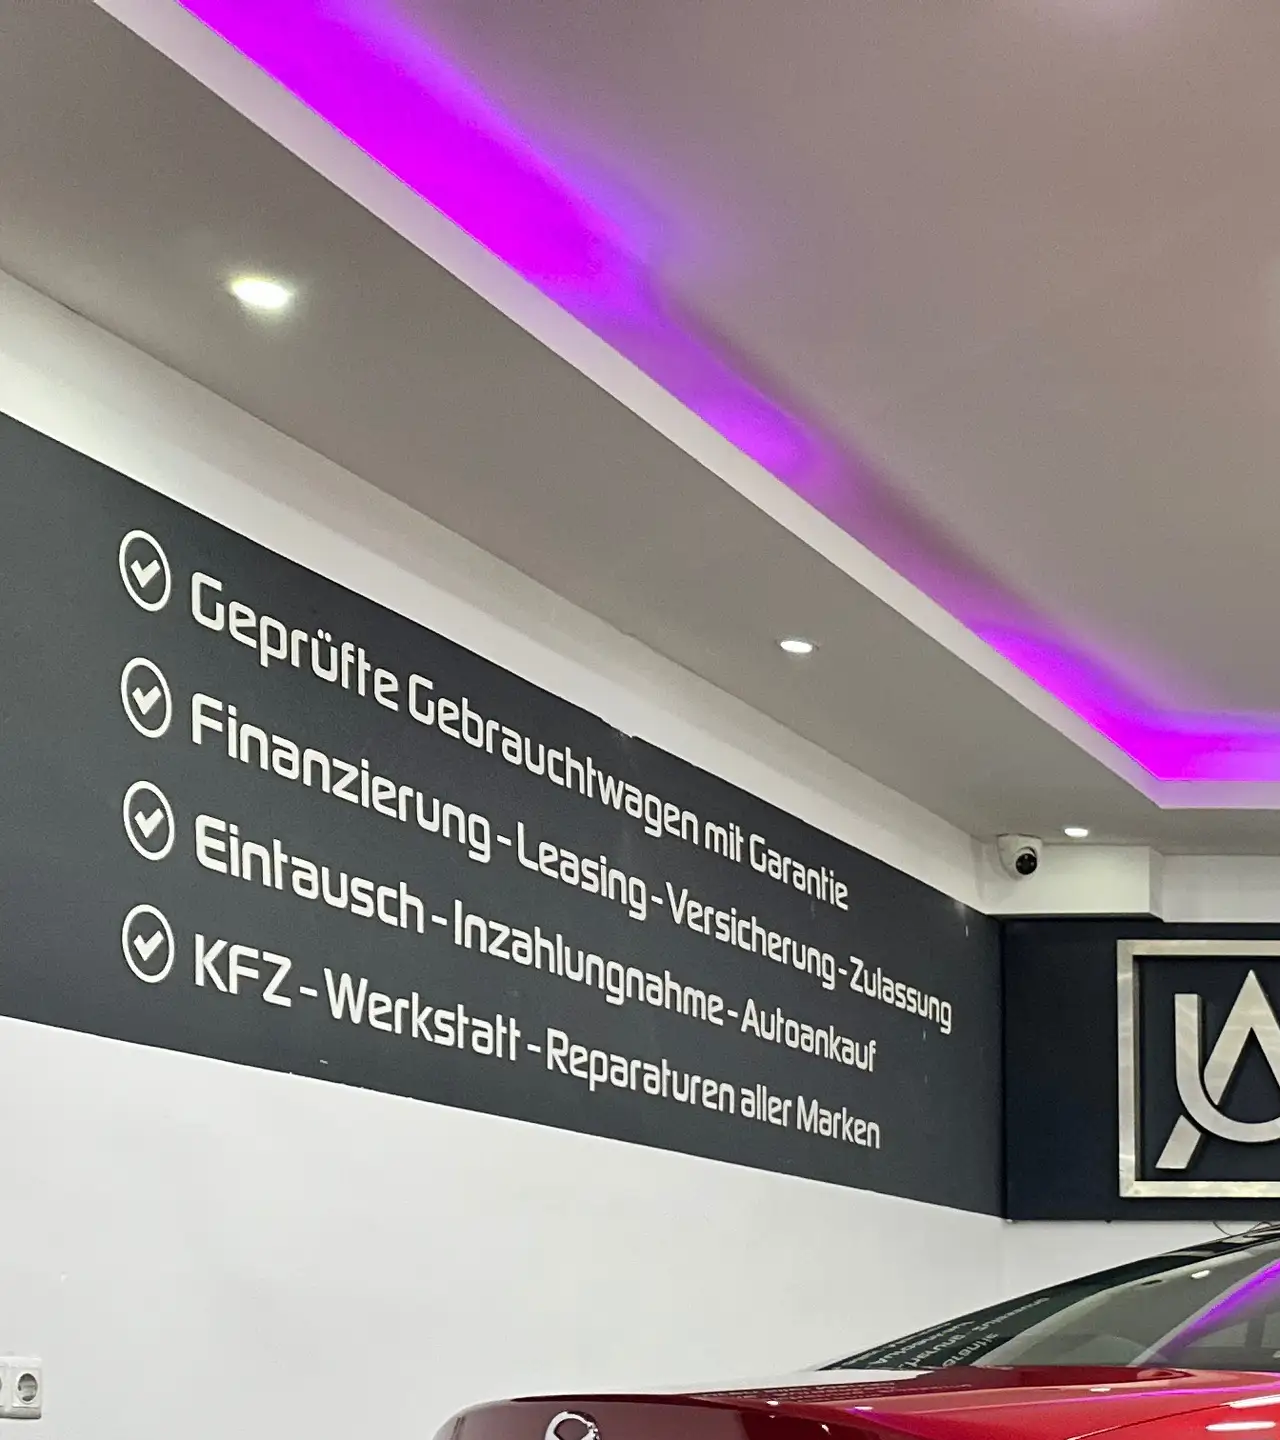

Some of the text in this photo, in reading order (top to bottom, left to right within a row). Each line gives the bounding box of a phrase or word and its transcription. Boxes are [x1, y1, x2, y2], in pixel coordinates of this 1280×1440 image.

[191, 571, 849, 910] Geprüfte Gebrauchtwagen mit Garantie
[740, 1085, 792, 1129] aller
[797, 1095, 881, 1149] Marken
